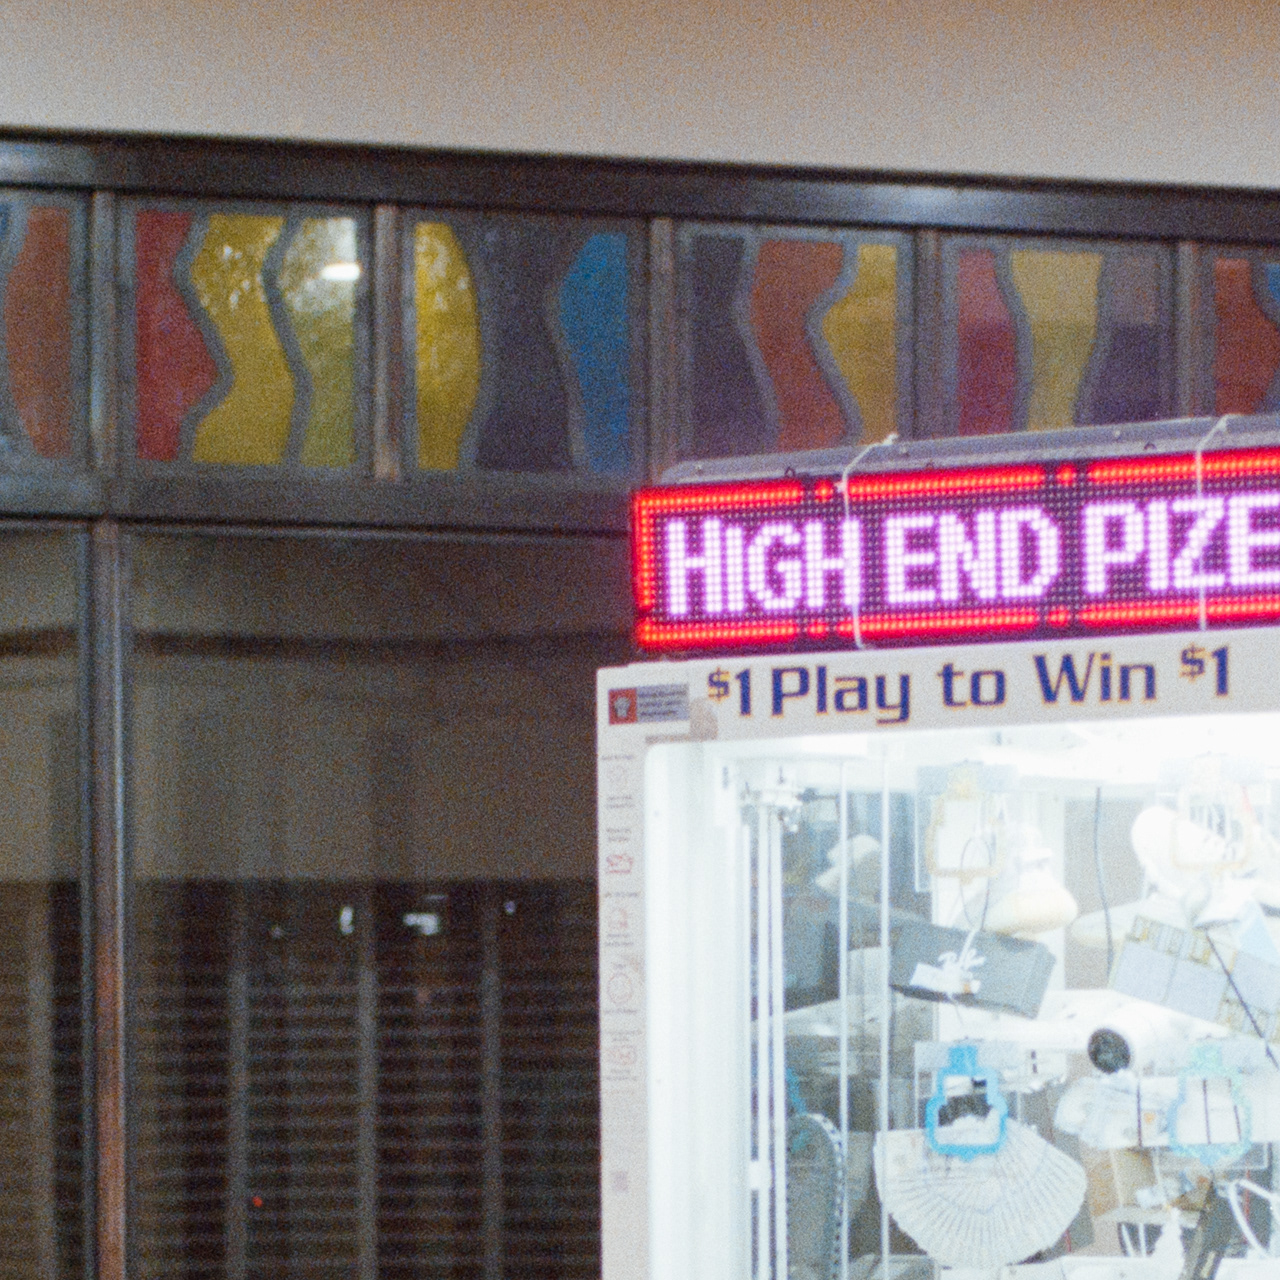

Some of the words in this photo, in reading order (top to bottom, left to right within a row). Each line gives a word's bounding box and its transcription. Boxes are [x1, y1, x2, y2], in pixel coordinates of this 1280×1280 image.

[666, 516, 863, 616] HIGH
[885, 507, 1061, 604] END
[707, 667, 752, 717] $1
[770, 663, 912, 726] Play
[936, 662, 1008, 708] to
[1032, 651, 1158, 705] Win
[1179, 643, 1231, 699] $1
